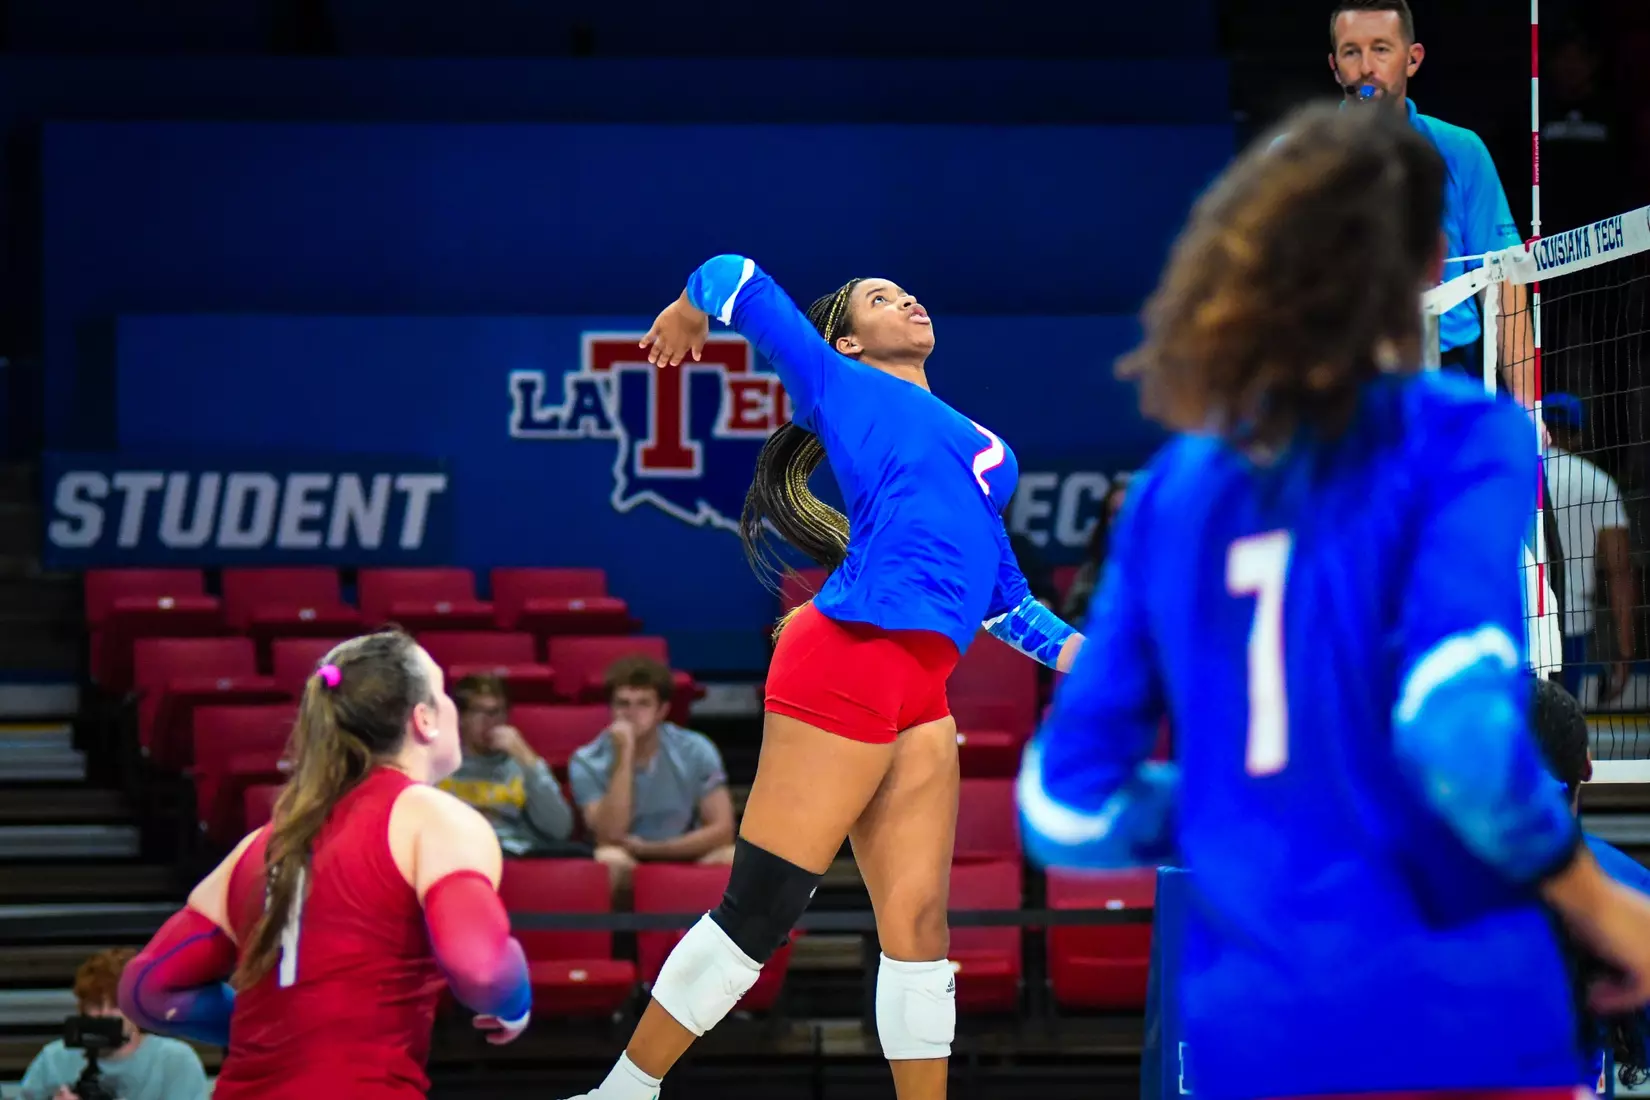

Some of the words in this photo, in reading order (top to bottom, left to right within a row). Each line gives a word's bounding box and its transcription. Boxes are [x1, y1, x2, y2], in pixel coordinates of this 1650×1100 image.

[1533, 226, 1591, 271] LOUISIANA
[1594, 216, 1624, 254] TECH
[510, 371, 622, 438] LA
[581, 332, 795, 478] TE
[48, 471, 448, 549] STUDENT
[1010, 471, 1133, 547] EC
[1224, 527, 1292, 777] 1
